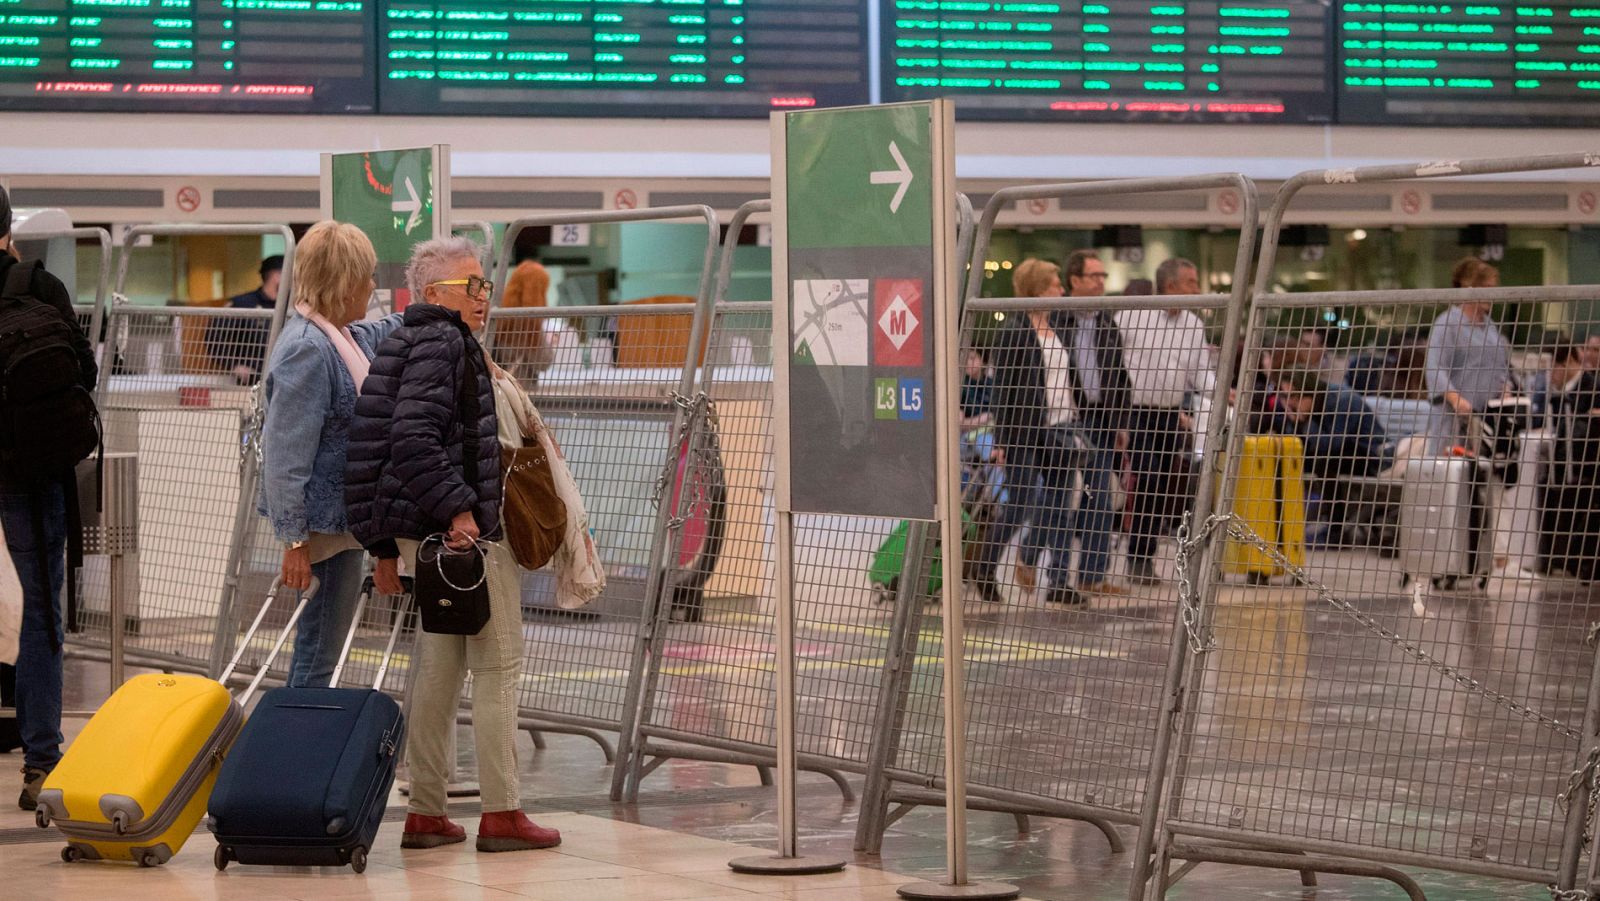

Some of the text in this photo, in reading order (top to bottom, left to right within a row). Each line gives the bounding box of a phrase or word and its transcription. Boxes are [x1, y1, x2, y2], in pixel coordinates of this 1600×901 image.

[562, 225, 578, 242] 25
[890, 310, 907, 336] M
[877, 386, 922, 411] L3 L5
